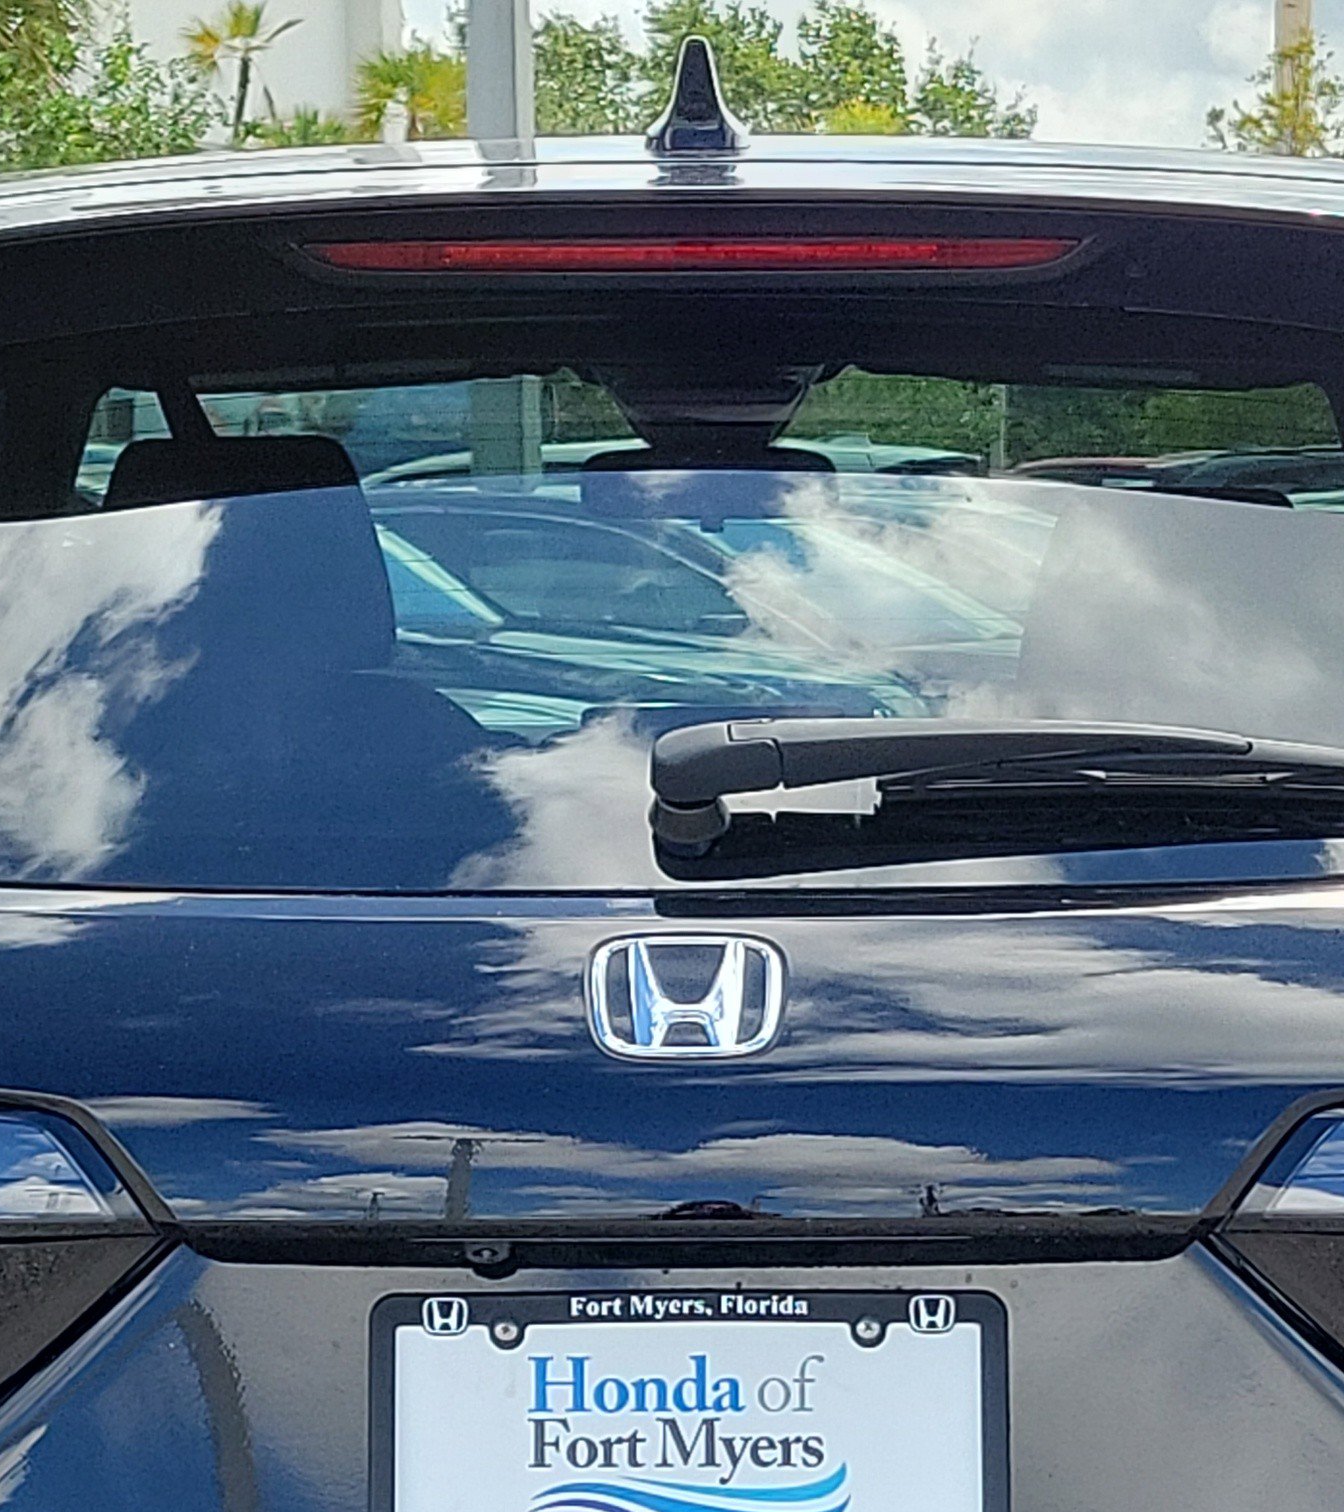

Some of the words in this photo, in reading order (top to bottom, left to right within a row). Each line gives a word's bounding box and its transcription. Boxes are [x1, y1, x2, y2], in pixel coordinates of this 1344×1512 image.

[570, 1296, 622, 1316] Fort
[630, 1295, 713, 1319] Myers,
[721, 1295, 808, 1315] Florida
[527, 1354, 745, 1413] Honda
[757, 1355, 824, 1413] of
[527, 1417, 646, 1468] Fort
[654, 1417, 824, 1485] Myers
